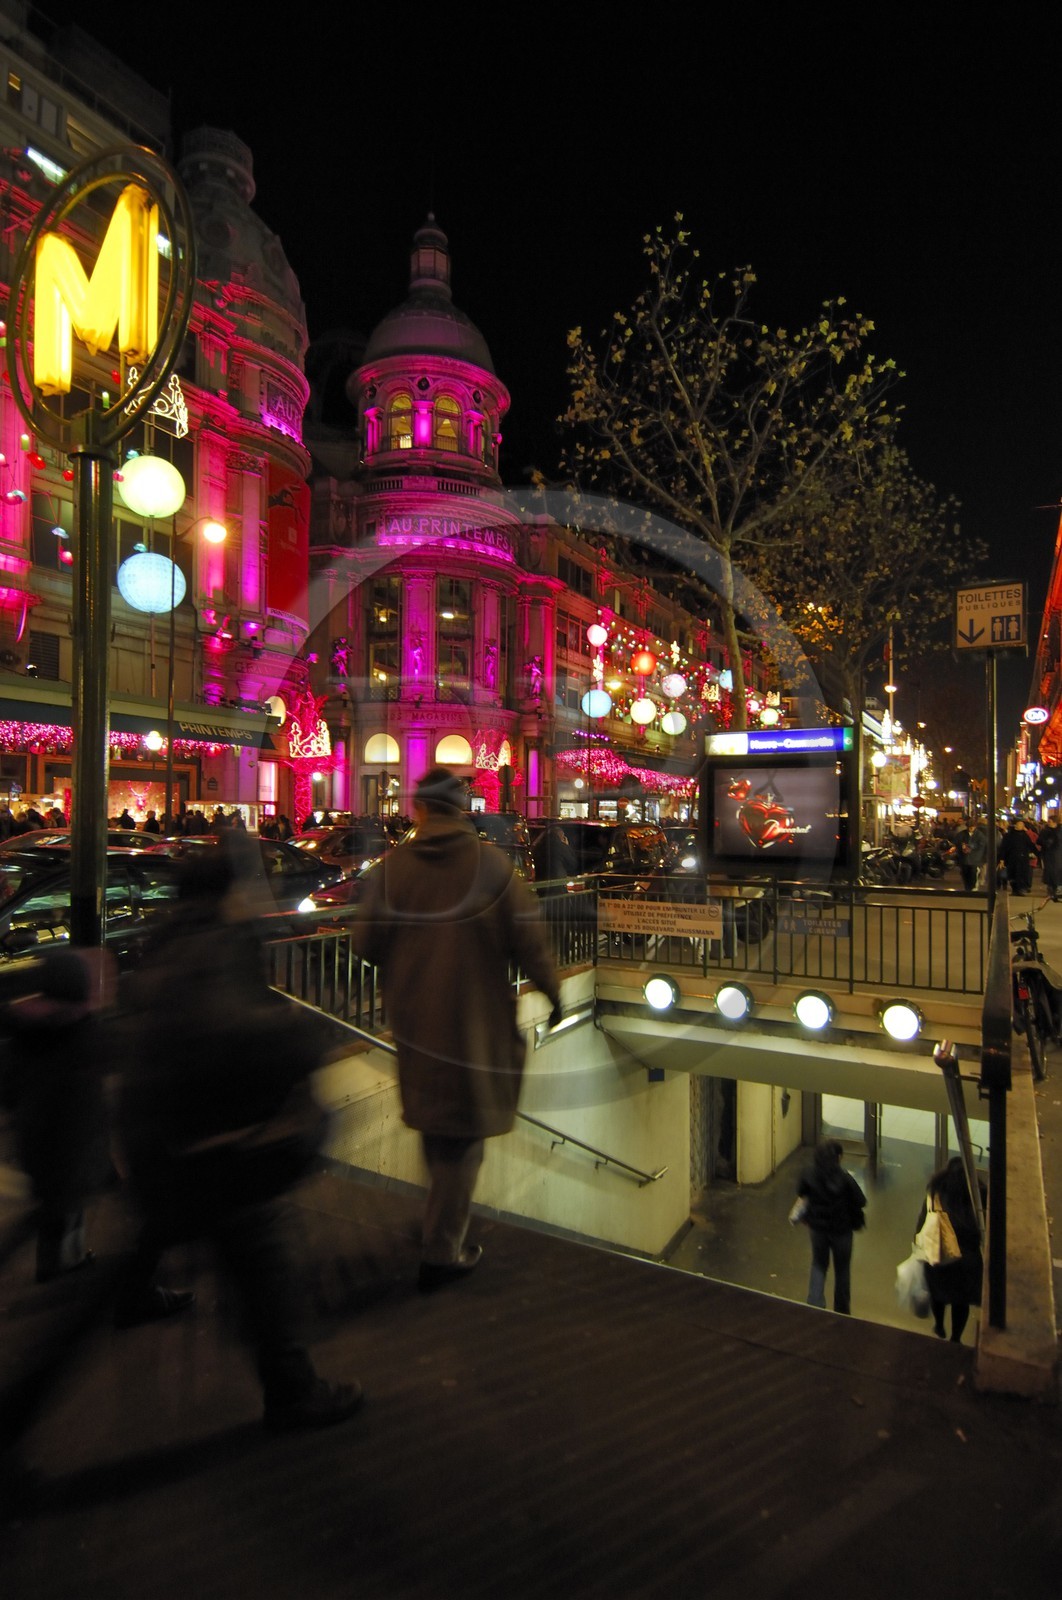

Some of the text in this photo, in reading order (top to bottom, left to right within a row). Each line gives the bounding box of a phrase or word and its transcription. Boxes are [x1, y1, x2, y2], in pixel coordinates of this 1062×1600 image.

[34, 182, 159, 396] M
[389, 518, 509, 550] AU PRINTEMPS
[958, 588, 1021, 604] TOILETTES
[958, 600, 1021, 612] PUBLIQUES
[178, 721, 253, 740] PRINTEMPS
[642, 925, 675, 933] BOULEVARD
[676, 927, 715, 936] HAUSSMANN
